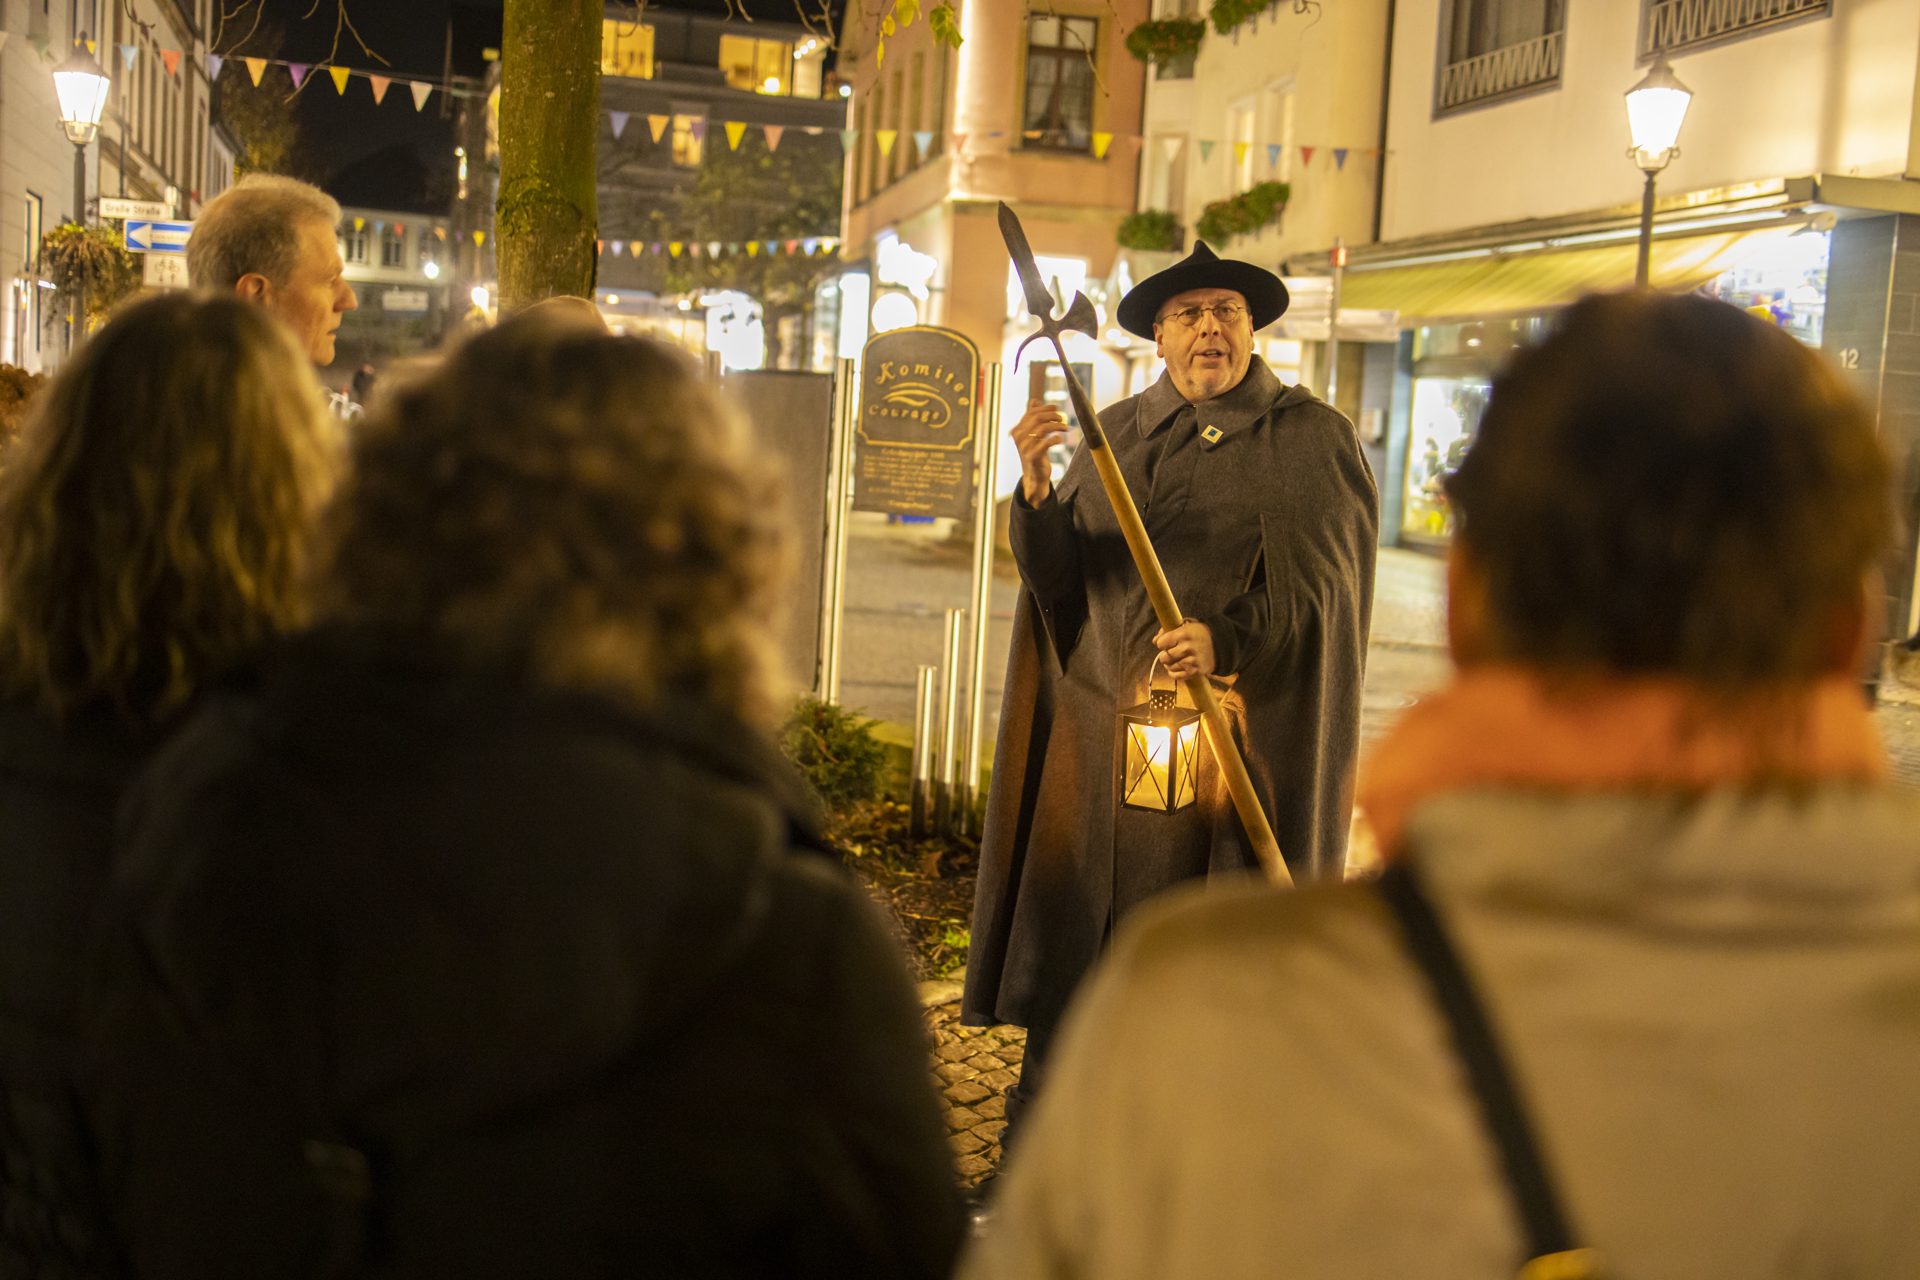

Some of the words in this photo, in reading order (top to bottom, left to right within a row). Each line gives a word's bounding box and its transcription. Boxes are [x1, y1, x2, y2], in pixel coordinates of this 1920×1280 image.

[133, 205, 161, 217] Straße
[1839, 347, 1860, 370] 12
[874, 360, 970, 406] Komitee
[868, 404, 940, 423] Courage
